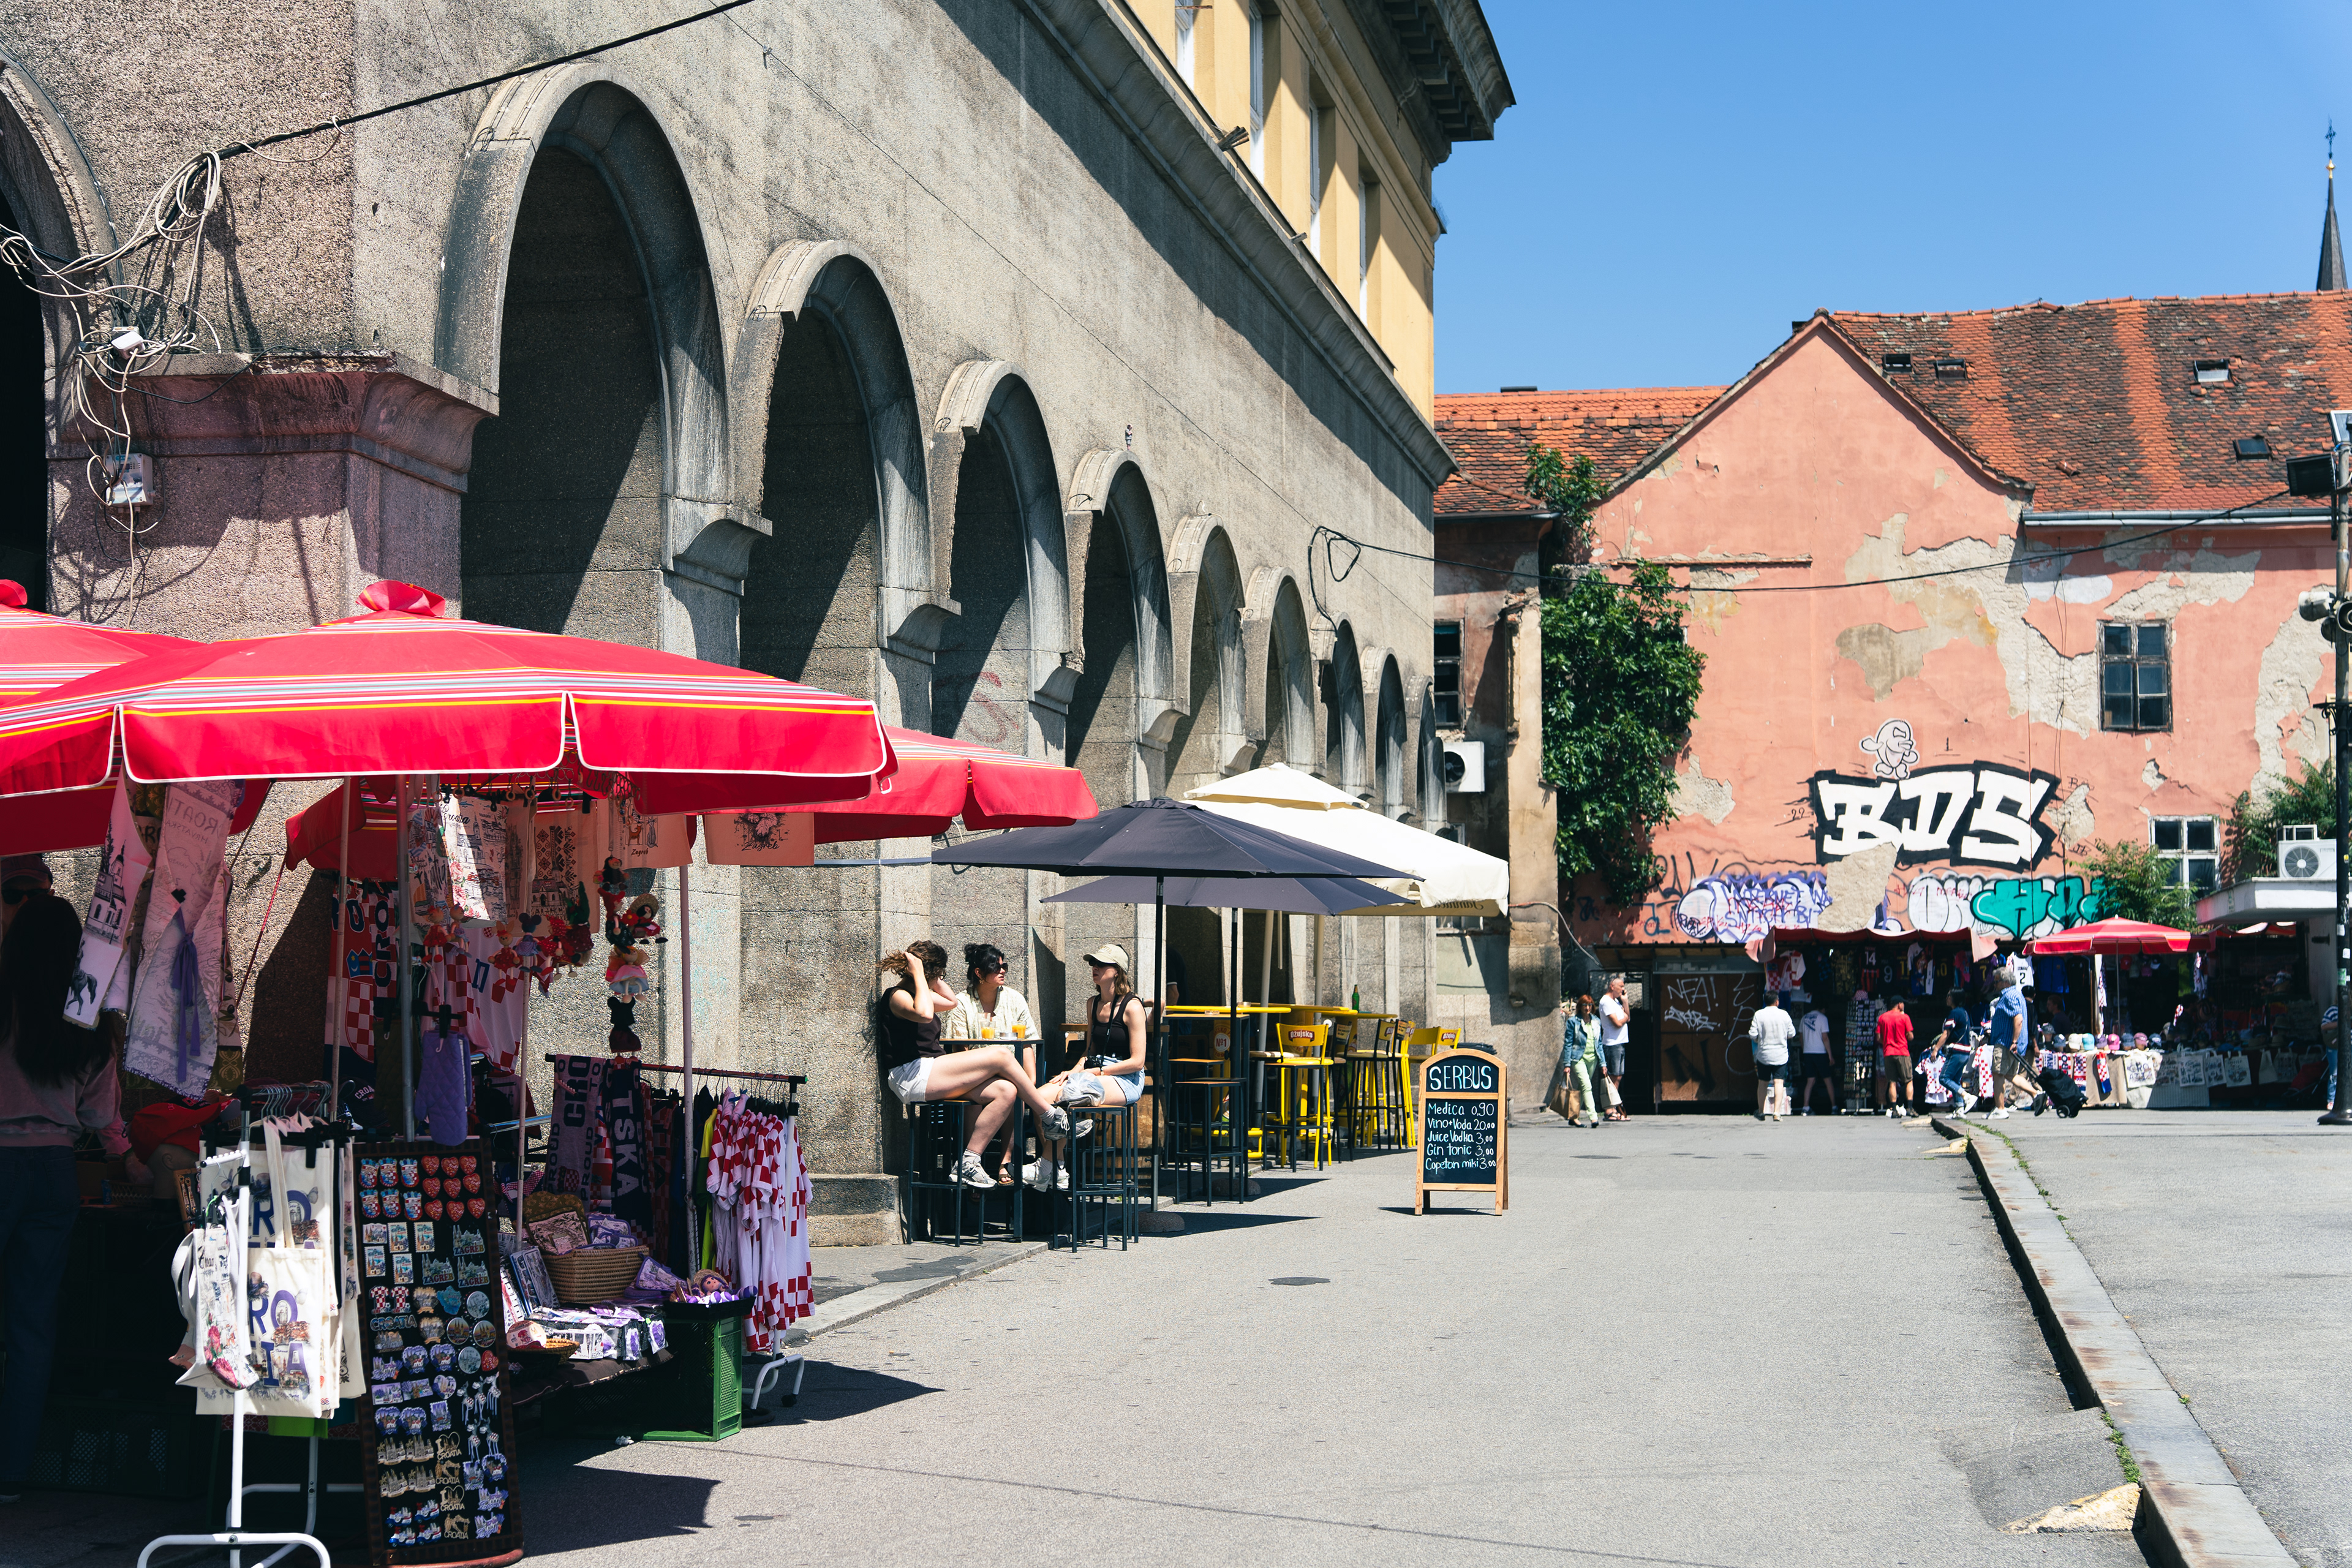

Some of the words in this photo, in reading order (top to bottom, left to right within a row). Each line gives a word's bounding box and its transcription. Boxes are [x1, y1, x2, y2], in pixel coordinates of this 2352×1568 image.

[742, 840, 780, 852] Zagreb
[631, 848, 649, 857] Zagreb
[1864, 951, 1877, 966] 14
[1883, 965, 1893, 984] 9
[1980, 965, 1987, 982] 7
[2019, 972, 2026, 984] 2
[1667, 976, 1719, 1012] NFA!
[1290, 1030, 1313, 1039] Ožujsko
[1429, 1065, 1491, 1090] SERBUS
[1428, 1101, 1464, 1115] Medica
[1471, 1102, 1494, 1117] 0,90
[1474, 1119, 1495, 1131] 20,00
[581, 1126, 594, 1202] PROUD
[589, 1062, 601, 1092] TO
[1428, 1131, 1449, 1142] Juice
[1450, 1131, 1474, 1143] Vodka
[1476, 1132, 1493, 1145] 3,00
[1427, 1144, 1444, 1156] Gin
[1447, 1143, 1472, 1156] tonic
[1476, 1145, 1494, 1157] 3,00
[1461, 1158, 1479, 1168] miki
[454, 1244, 484, 1255] ZAGREB
[423, 1273, 454, 1284] ZAGREB
[459, 1276, 489, 1287] ZAGREB
[371, 1315, 417, 1331] CROATIA
[437, 1448, 462, 1461] CROATIA
[435, 1476, 461, 1485] CROATIA
[440, 1503, 466, 1512] CROATIA
[443, 1530, 469, 1540] CROATIA
